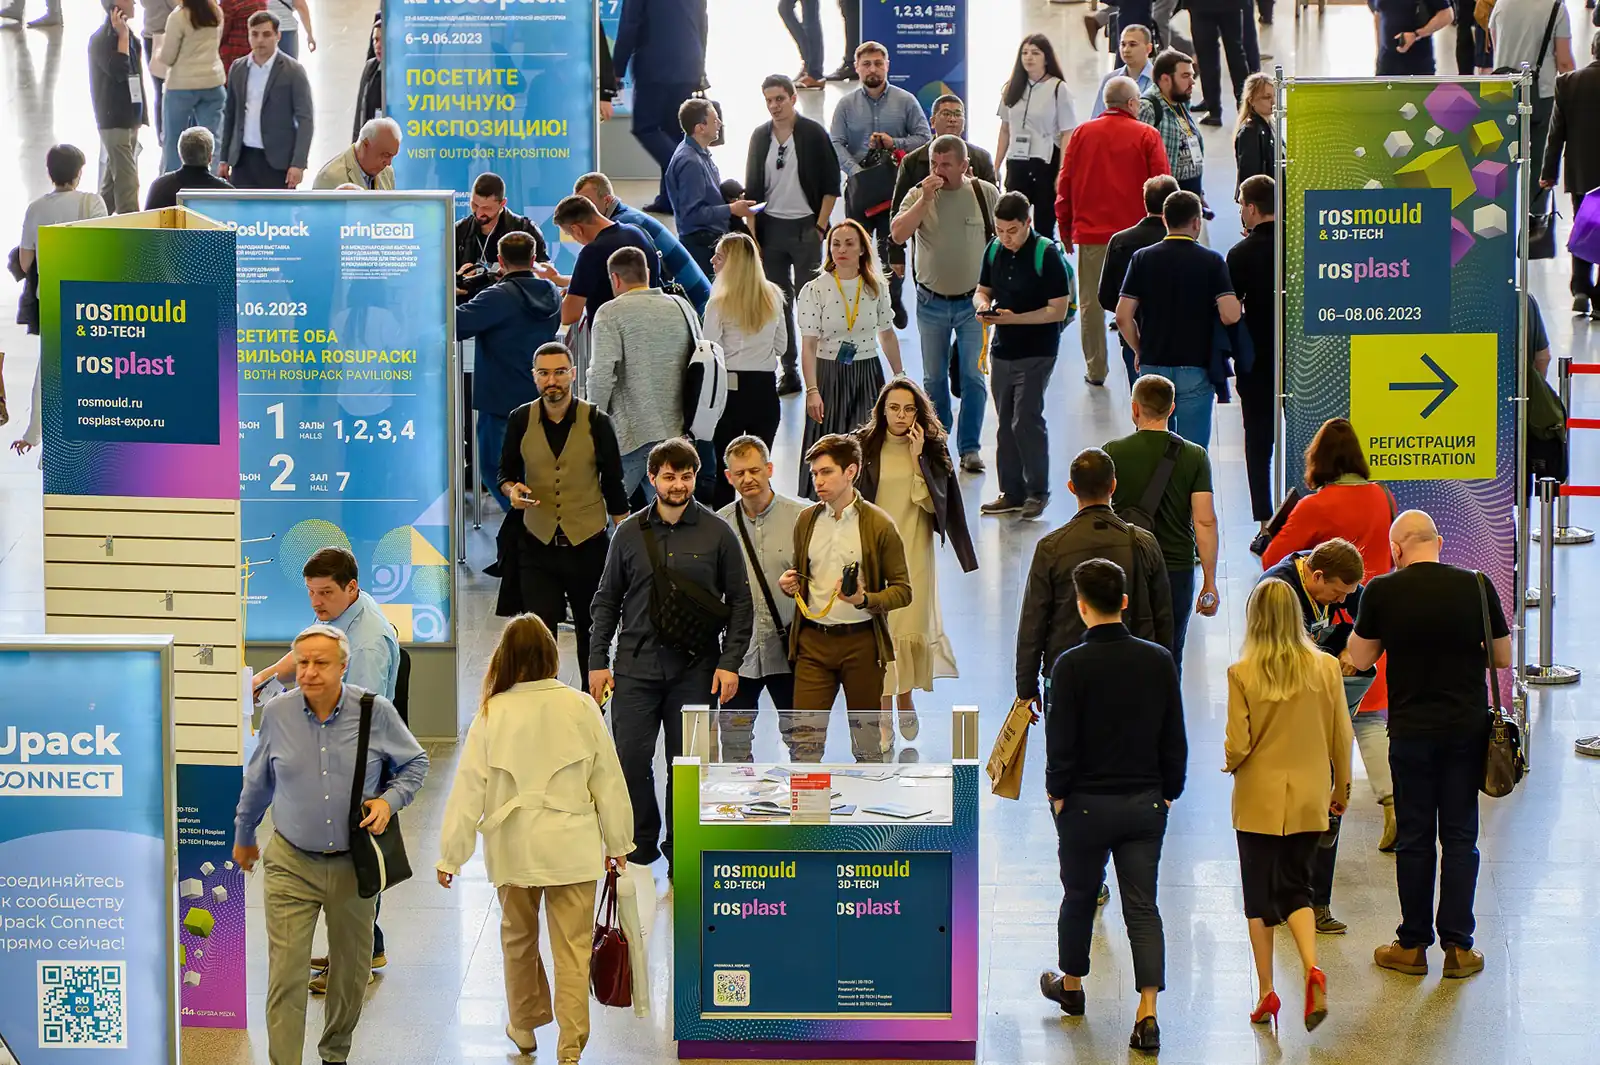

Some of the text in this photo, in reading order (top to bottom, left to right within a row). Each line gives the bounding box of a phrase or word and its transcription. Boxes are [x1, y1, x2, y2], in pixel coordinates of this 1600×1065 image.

[608, 0, 618, 14] 7
[940, 44, 950, 55] F
[406, 68, 519, 86] ПОСЕТИТЕ
[406, 94, 516, 112] УЛИЧНУЮ
[406, 119, 568, 140] ЭКСПОЗИЦИЮ!
[407, 147, 570, 159] VISIT OUTDOOR EXPOSITION!
[1318, 202, 1423, 226] rosmould
[340, 220, 411, 239] printech
[1319, 228, 1384, 240] & 3D-TECH
[1318, 257, 1411, 283] rosplast
[75, 299, 187, 323] rosmould
[75, 325, 146, 338] & 3D-TECH
[237, 329, 338, 344] СЕТИТЕ ОБА
[321, 349, 417, 364] ROSUPACK!
[75, 351, 176, 379] rosplast
[244, 369, 277, 380] BOTH
[280, 369, 343, 380] ROSUPACK
[346, 369, 412, 381] PAVILIONS!
[77, 397, 143, 410] rosmould.ru
[77, 414, 165, 429] rosplast-expo.ru
[266, 402, 285, 440] 1
[299, 421, 325, 430] ЗАЛЫ
[299, 432, 323, 440] HALLS
[1369, 435, 1476, 450] РЕГИСТРАЦИЯ
[1369, 452, 1476, 466] REGISTRATION
[268, 453, 296, 492] 2
[309, 473, 328, 482] ЗАЛ
[336, 471, 351, 492] 7
[310, 484, 328, 492] HALL
[713, 861, 796, 878] rosmould
[0, 873, 125, 889] соединяйтесь
[713, 880, 766, 890] & 3D-TECH
[838, 879, 880, 889] 3D-TECH
[2, 893, 125, 912] к сообществу
[713, 898, 787, 919] rosplast
[0, 914, 125, 931] pack Connect
[57, 936, 126, 951] сейчас!
[75, 996, 89, 1005] RU
